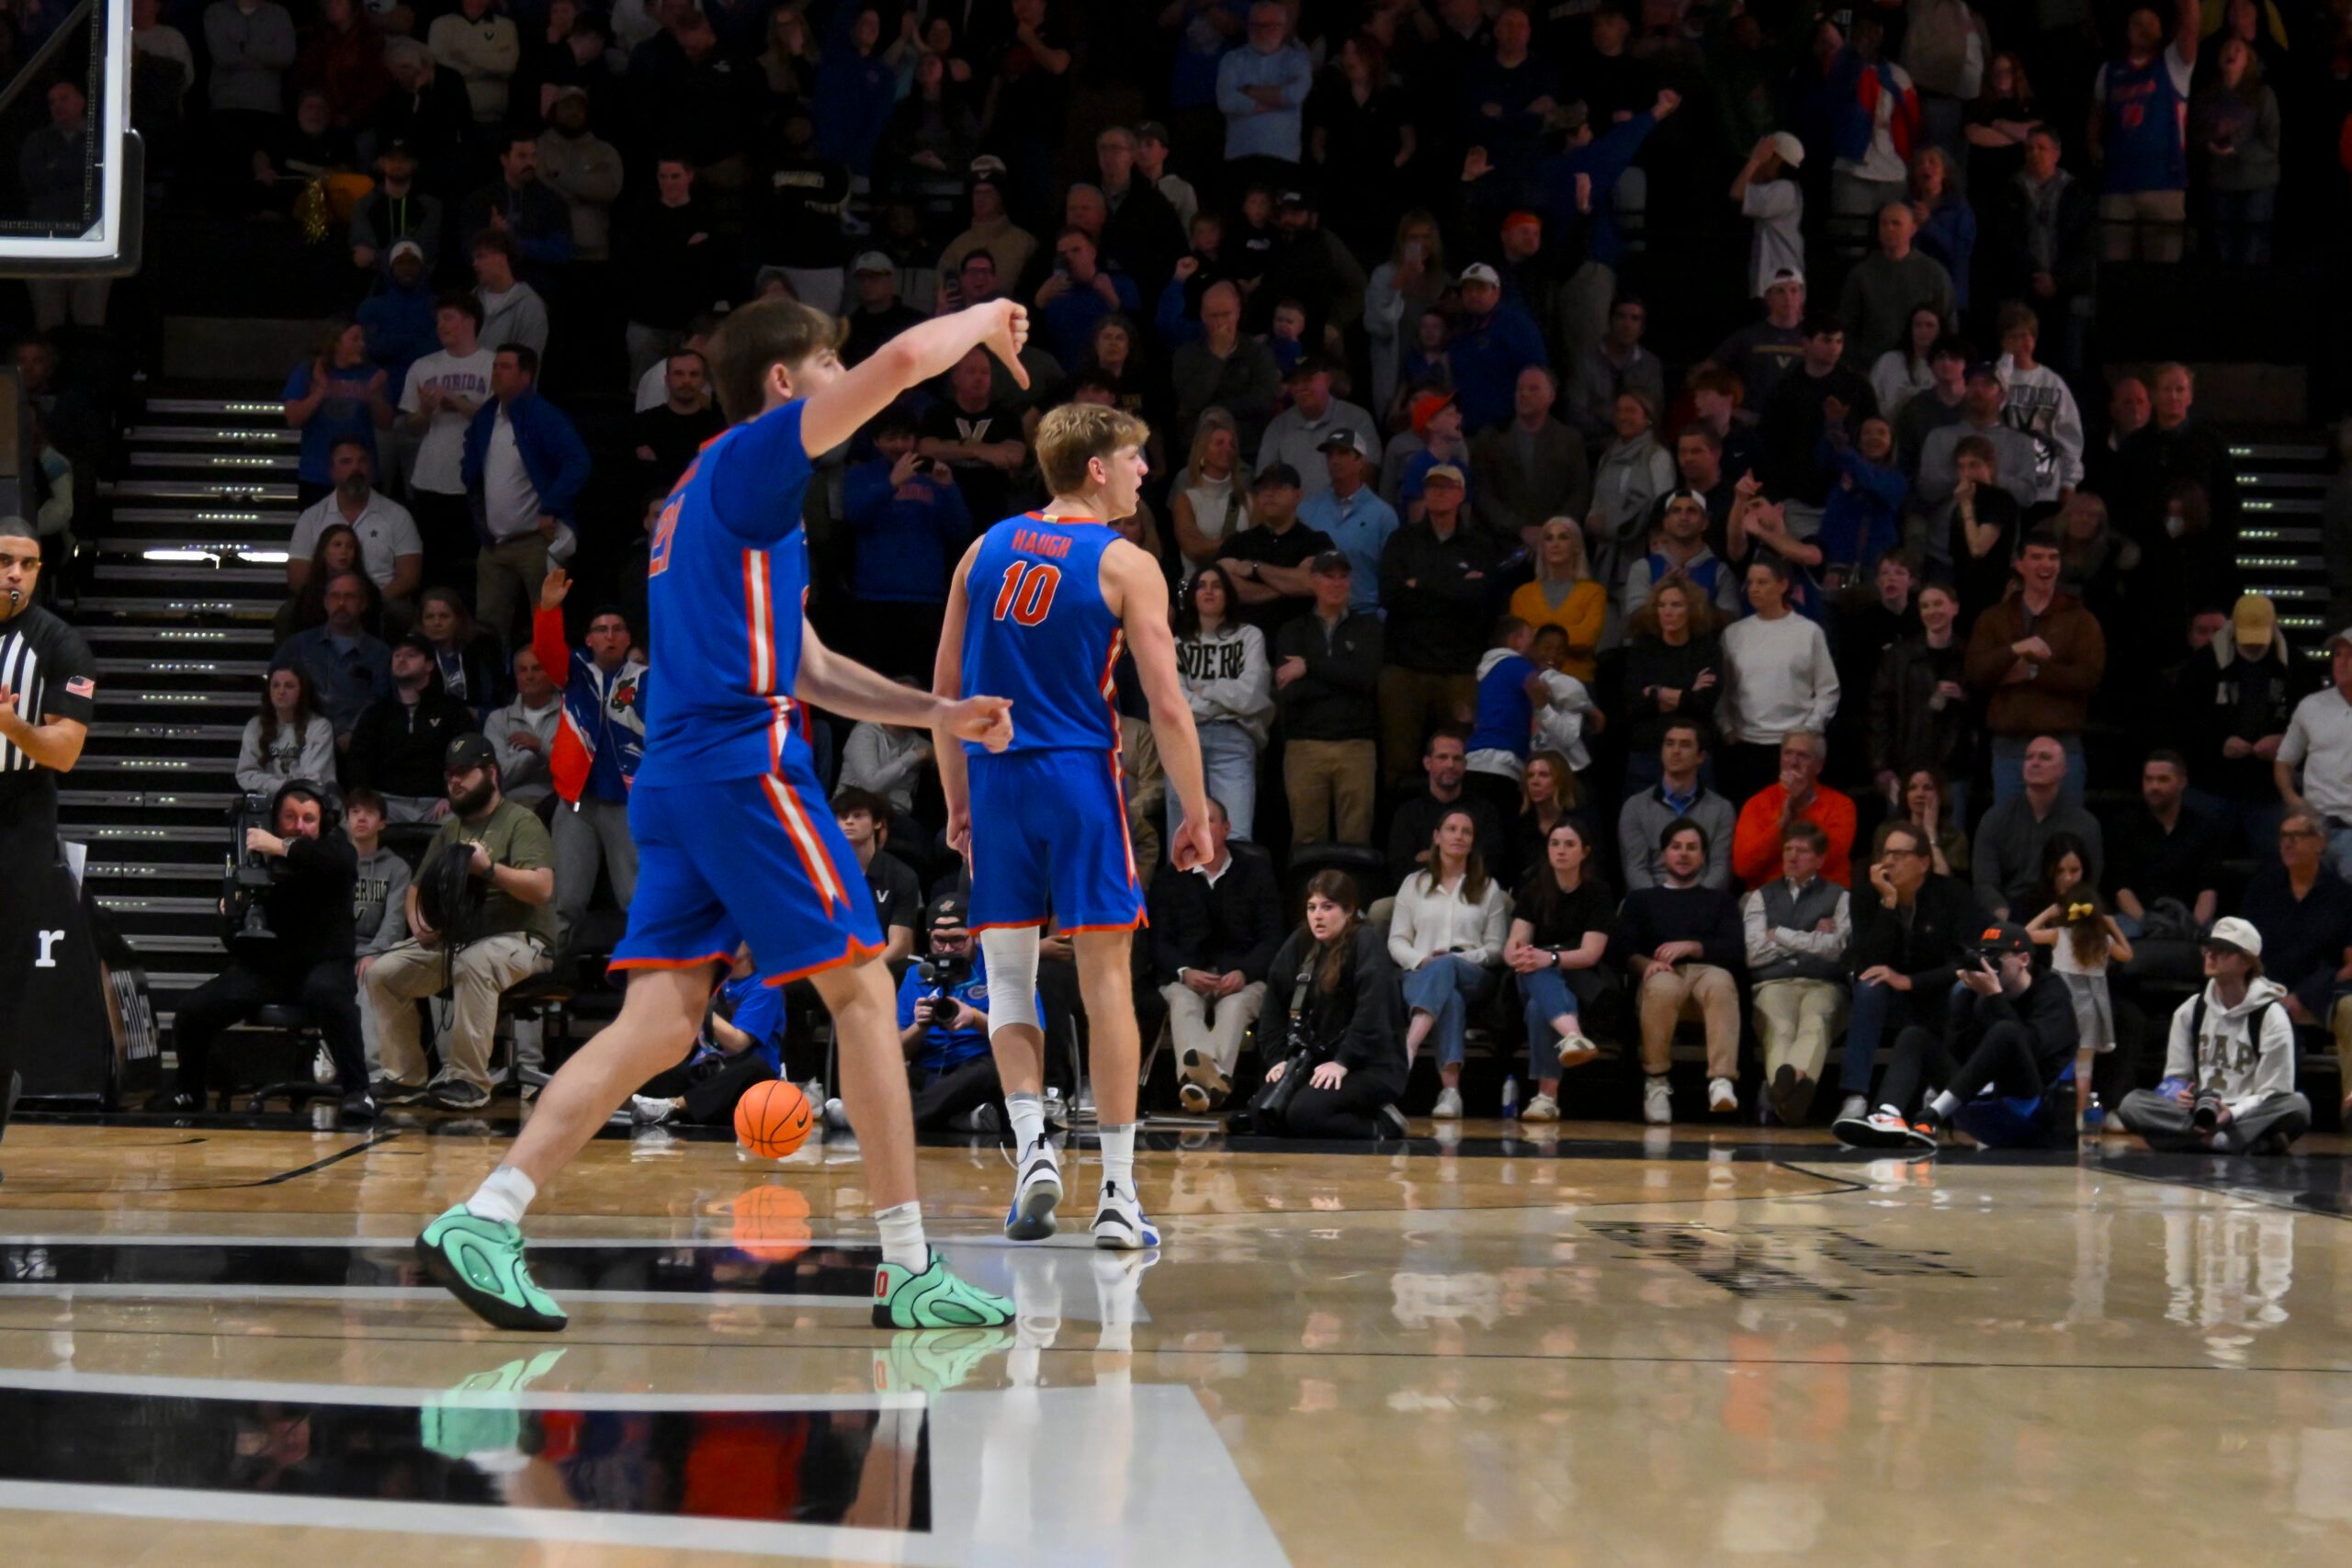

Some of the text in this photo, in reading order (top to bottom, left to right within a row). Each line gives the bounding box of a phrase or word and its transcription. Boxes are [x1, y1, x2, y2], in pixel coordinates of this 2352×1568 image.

[424, 373, 486, 394] ORIDA
[956, 417, 994, 443] V
[1012, 528, 1073, 559] HAUGH
[993, 559, 1062, 626] 10
[876, 889, 889, 903] V
[35, 930, 65, 967] r
[876, 1270, 888, 1297] 0
